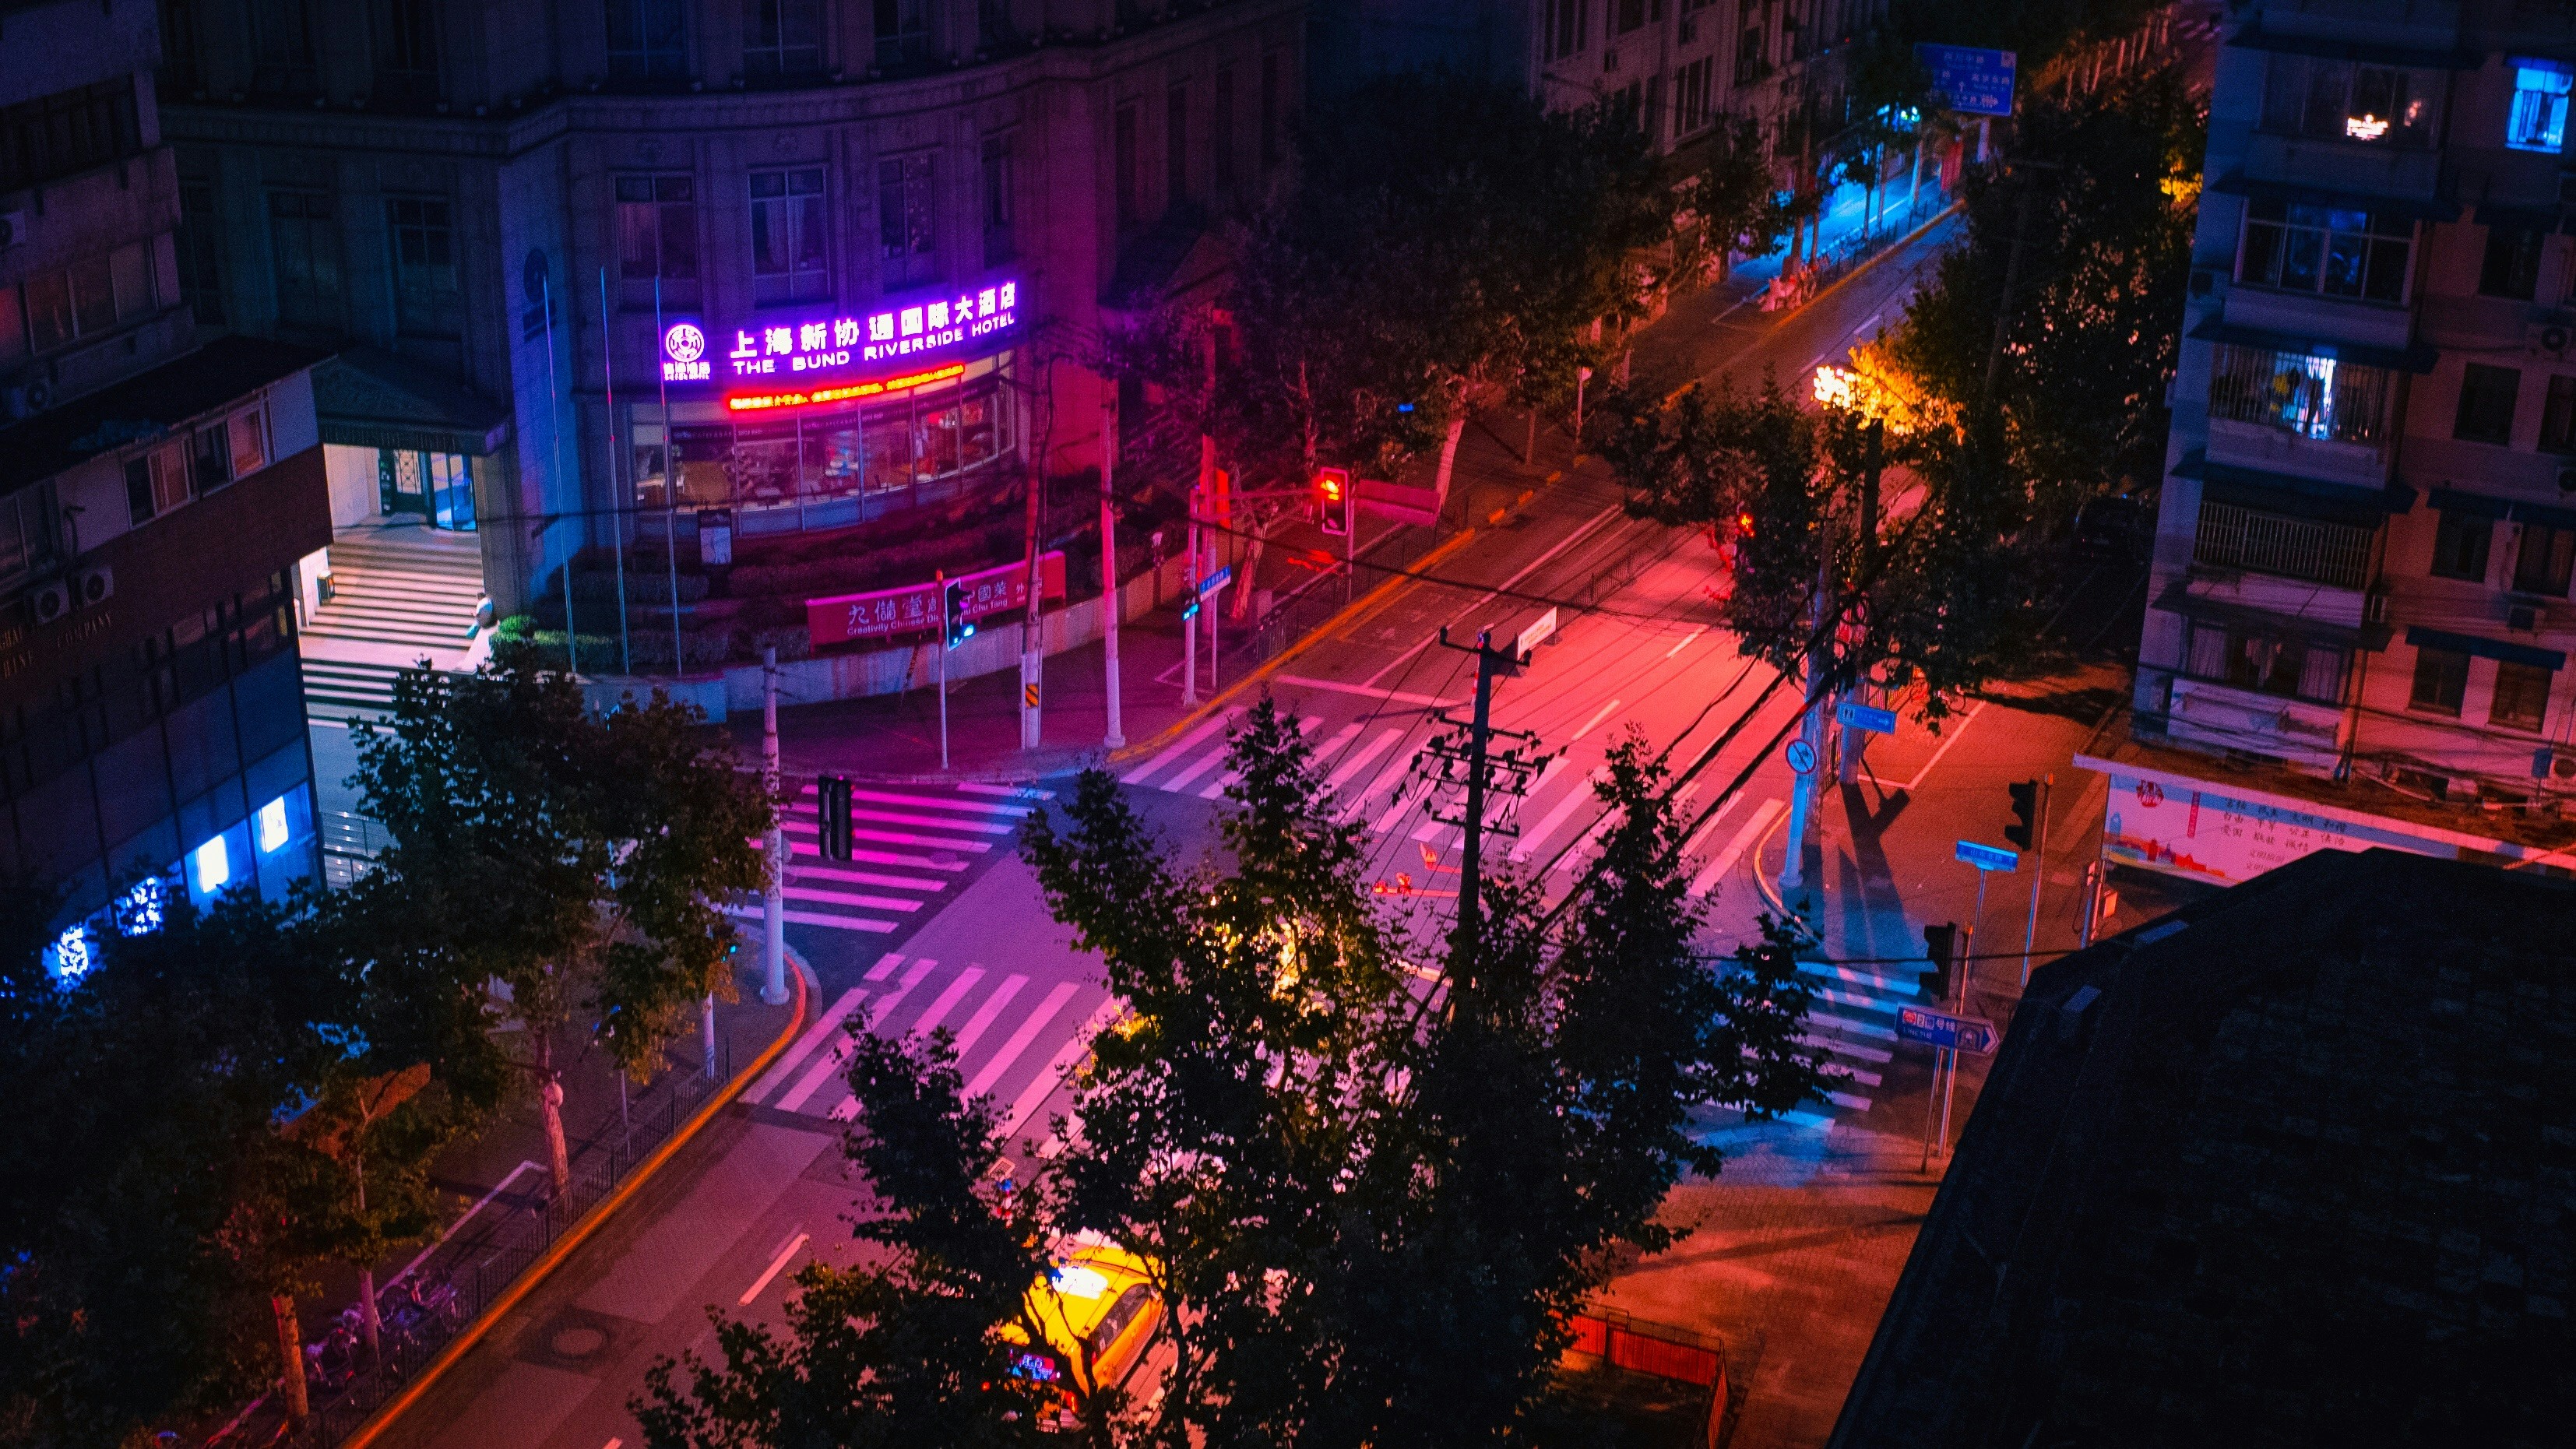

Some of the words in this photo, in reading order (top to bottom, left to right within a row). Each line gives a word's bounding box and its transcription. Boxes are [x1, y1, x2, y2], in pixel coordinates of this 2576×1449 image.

[733, 359, 775, 375] THE
[792, 350, 850, 371] BUND
[864, 329, 964, 361] RIVERSIDE
[972, 312, 1015, 337] HOTEL
[847, 622, 889, 636] Creativity
[891, 617, 925, 630] Chinese
[1936, 1017, 1955, 1032] 号线
